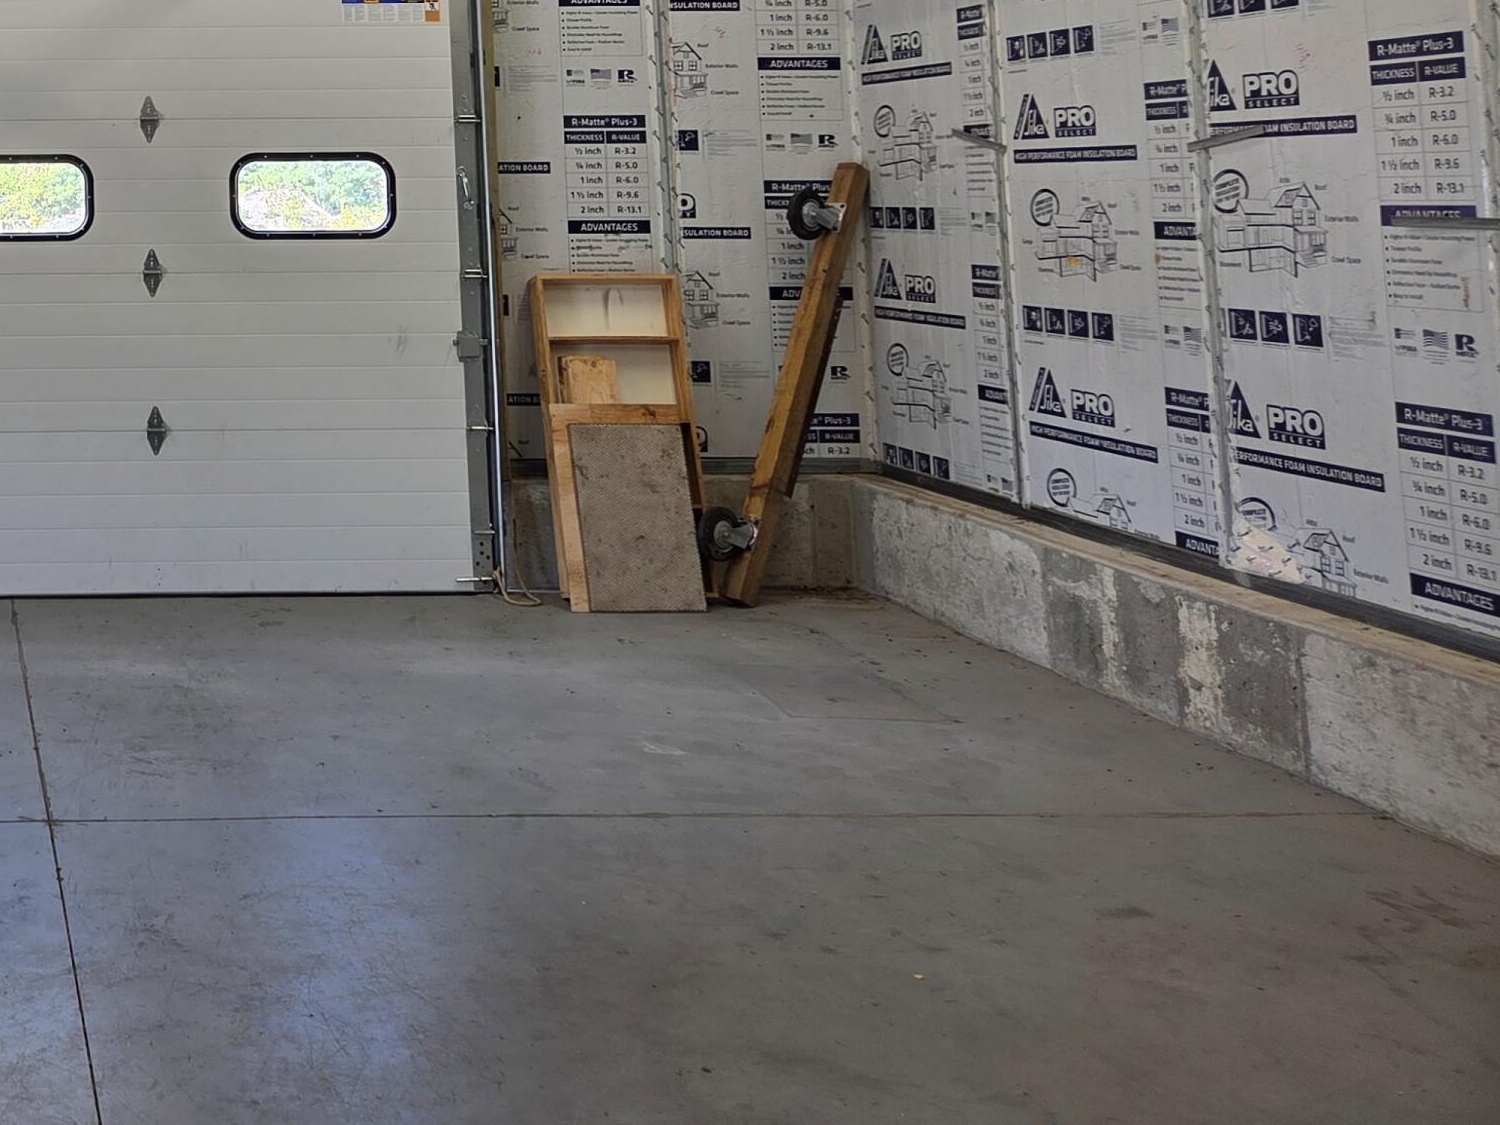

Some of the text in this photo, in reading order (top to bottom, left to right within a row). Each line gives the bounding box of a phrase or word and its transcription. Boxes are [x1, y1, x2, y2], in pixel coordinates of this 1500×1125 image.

[714, 1, 738, 9] BOARD
[807, 43, 831, 51] R-13.1
[1422, 37, 1454, 52] Plus-3
[770, 59, 828, 68] ADVANTAGES
[1371, 67, 1415, 81] THICKNESS
[1243, 70, 1299, 96] PRO
[1428, 86, 1454, 98] R-3.2
[1248, 96, 1297, 108] SELECT
[611, 118, 637, 126] Plus-3
[1054, 106, 1096, 126] PRO
[1430, 110, 1457, 123] R-5.0
[1327, 119, 1354, 130] BOARD
[1432, 134, 1459, 146] R-6.0
[581, 223, 638, 231] ADVANTAGES
[724, 229, 749, 237] BOARD
[905, 275, 936, 294] PRO
[1071, 389, 1116, 416] PRO
[825, 416, 851, 424] Plus-3
[1266, 404, 1324, 436] PRO
[1451, 413, 1483, 431] Plus-3
[1272, 431, 1322, 447] SELECT
[1398, 432, 1444, 450] THICKNESS
[1283, 458, 1383, 488] FOAM INSULATION BOARD
[1458, 464, 1484, 480] R-3.2
[1459, 489, 1488, 505] R-5.0
[1424, 581, 1493, 610] ADVANTAGES
